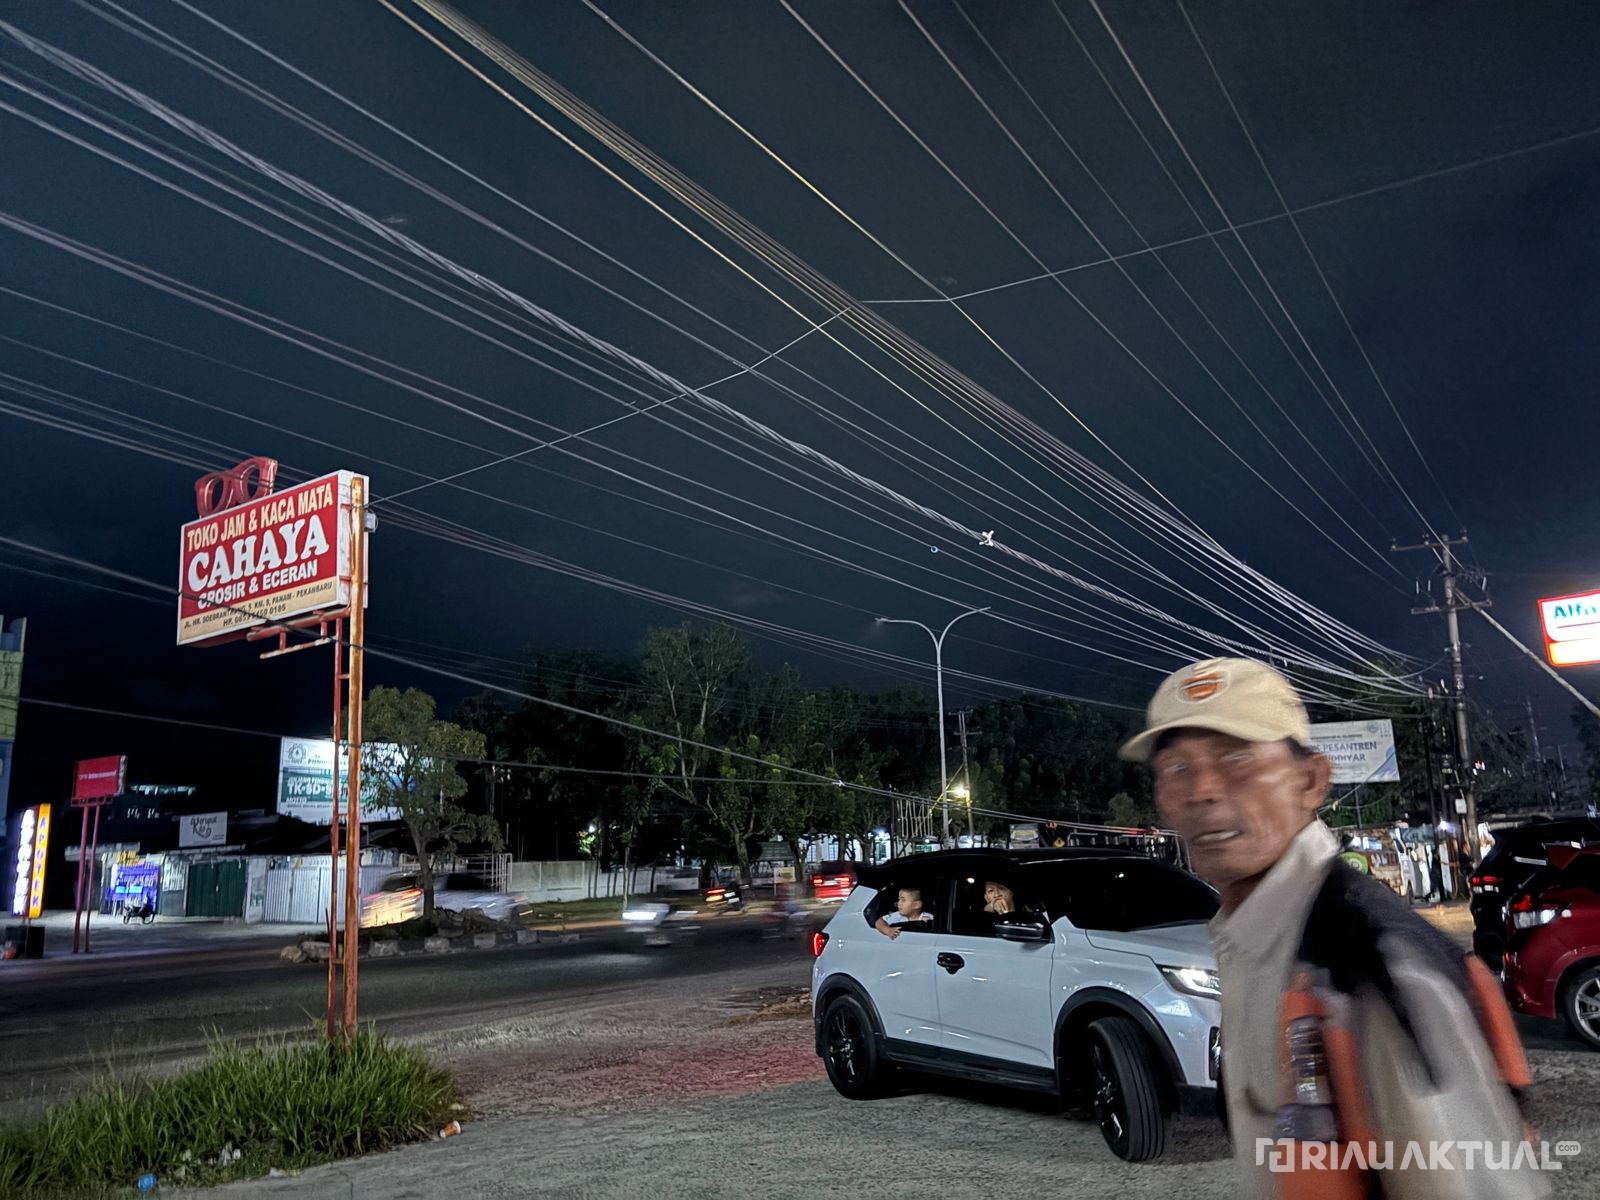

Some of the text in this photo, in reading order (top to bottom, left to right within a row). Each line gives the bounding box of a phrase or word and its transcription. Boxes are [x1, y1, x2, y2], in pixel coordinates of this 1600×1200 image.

[187, 483, 333, 552] TOKO JAM & KACA MATA
[188, 515, 330, 592] CAHAYA
[249, 577, 259, 593] &
[262, 560, 318, 591] ECERAN
[296, 581, 333, 598] PEKANBARU
[1323, 741, 1377, 753] PESANTREN
[31, 815, 47, 908] APOTEK
